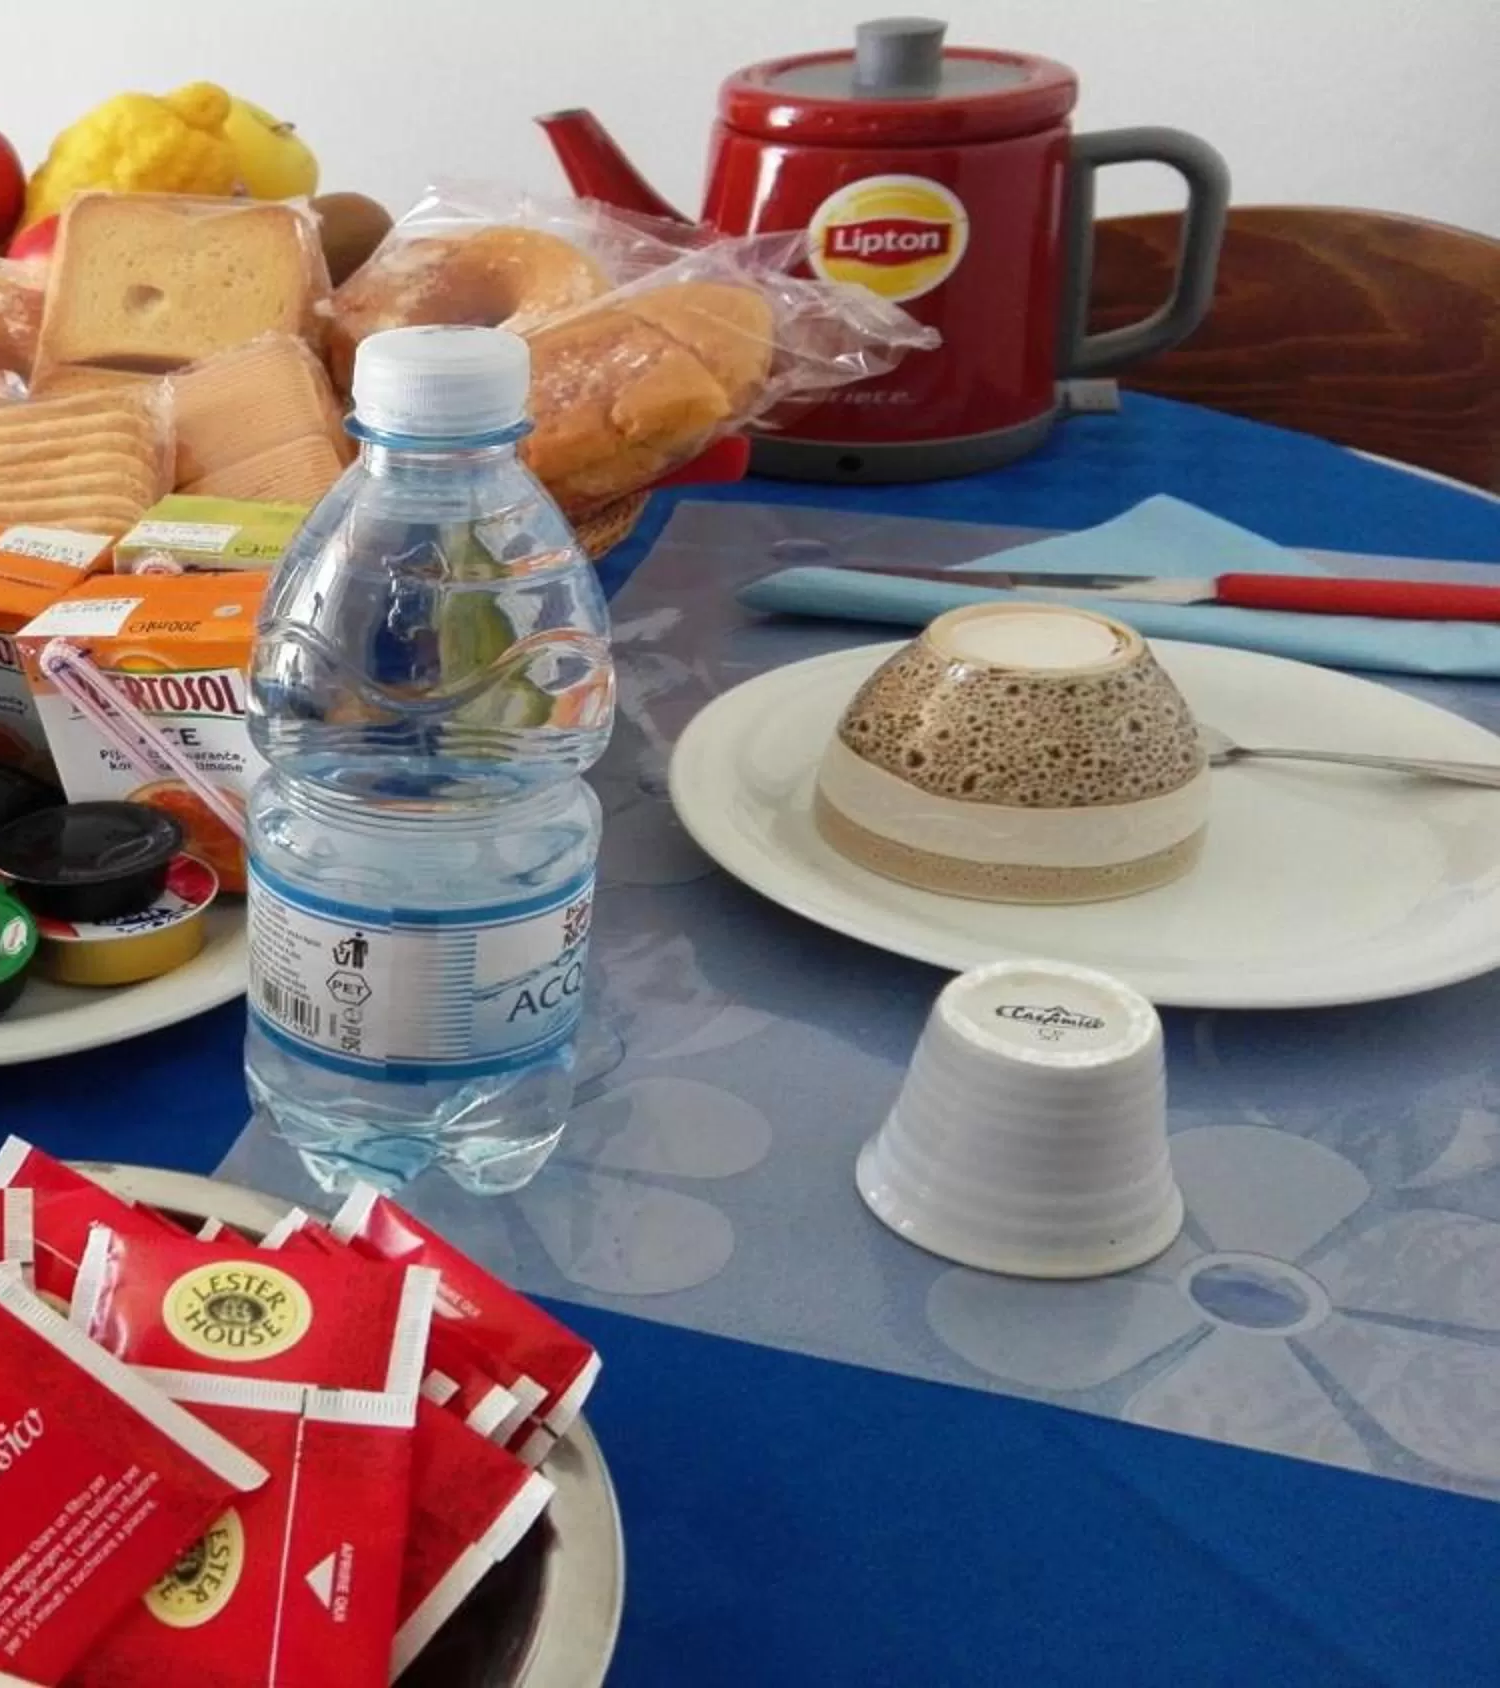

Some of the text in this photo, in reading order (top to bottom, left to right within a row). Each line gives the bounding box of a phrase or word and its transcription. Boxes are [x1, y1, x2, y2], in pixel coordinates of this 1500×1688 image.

[834, 227, 940, 256] Lipton
[332, 979, 363, 997] PET
[192, 1273, 288, 1312] LESTER
[184, 1308, 284, 1347] HOUSE
[188, 1527, 230, 1605] ESTER
